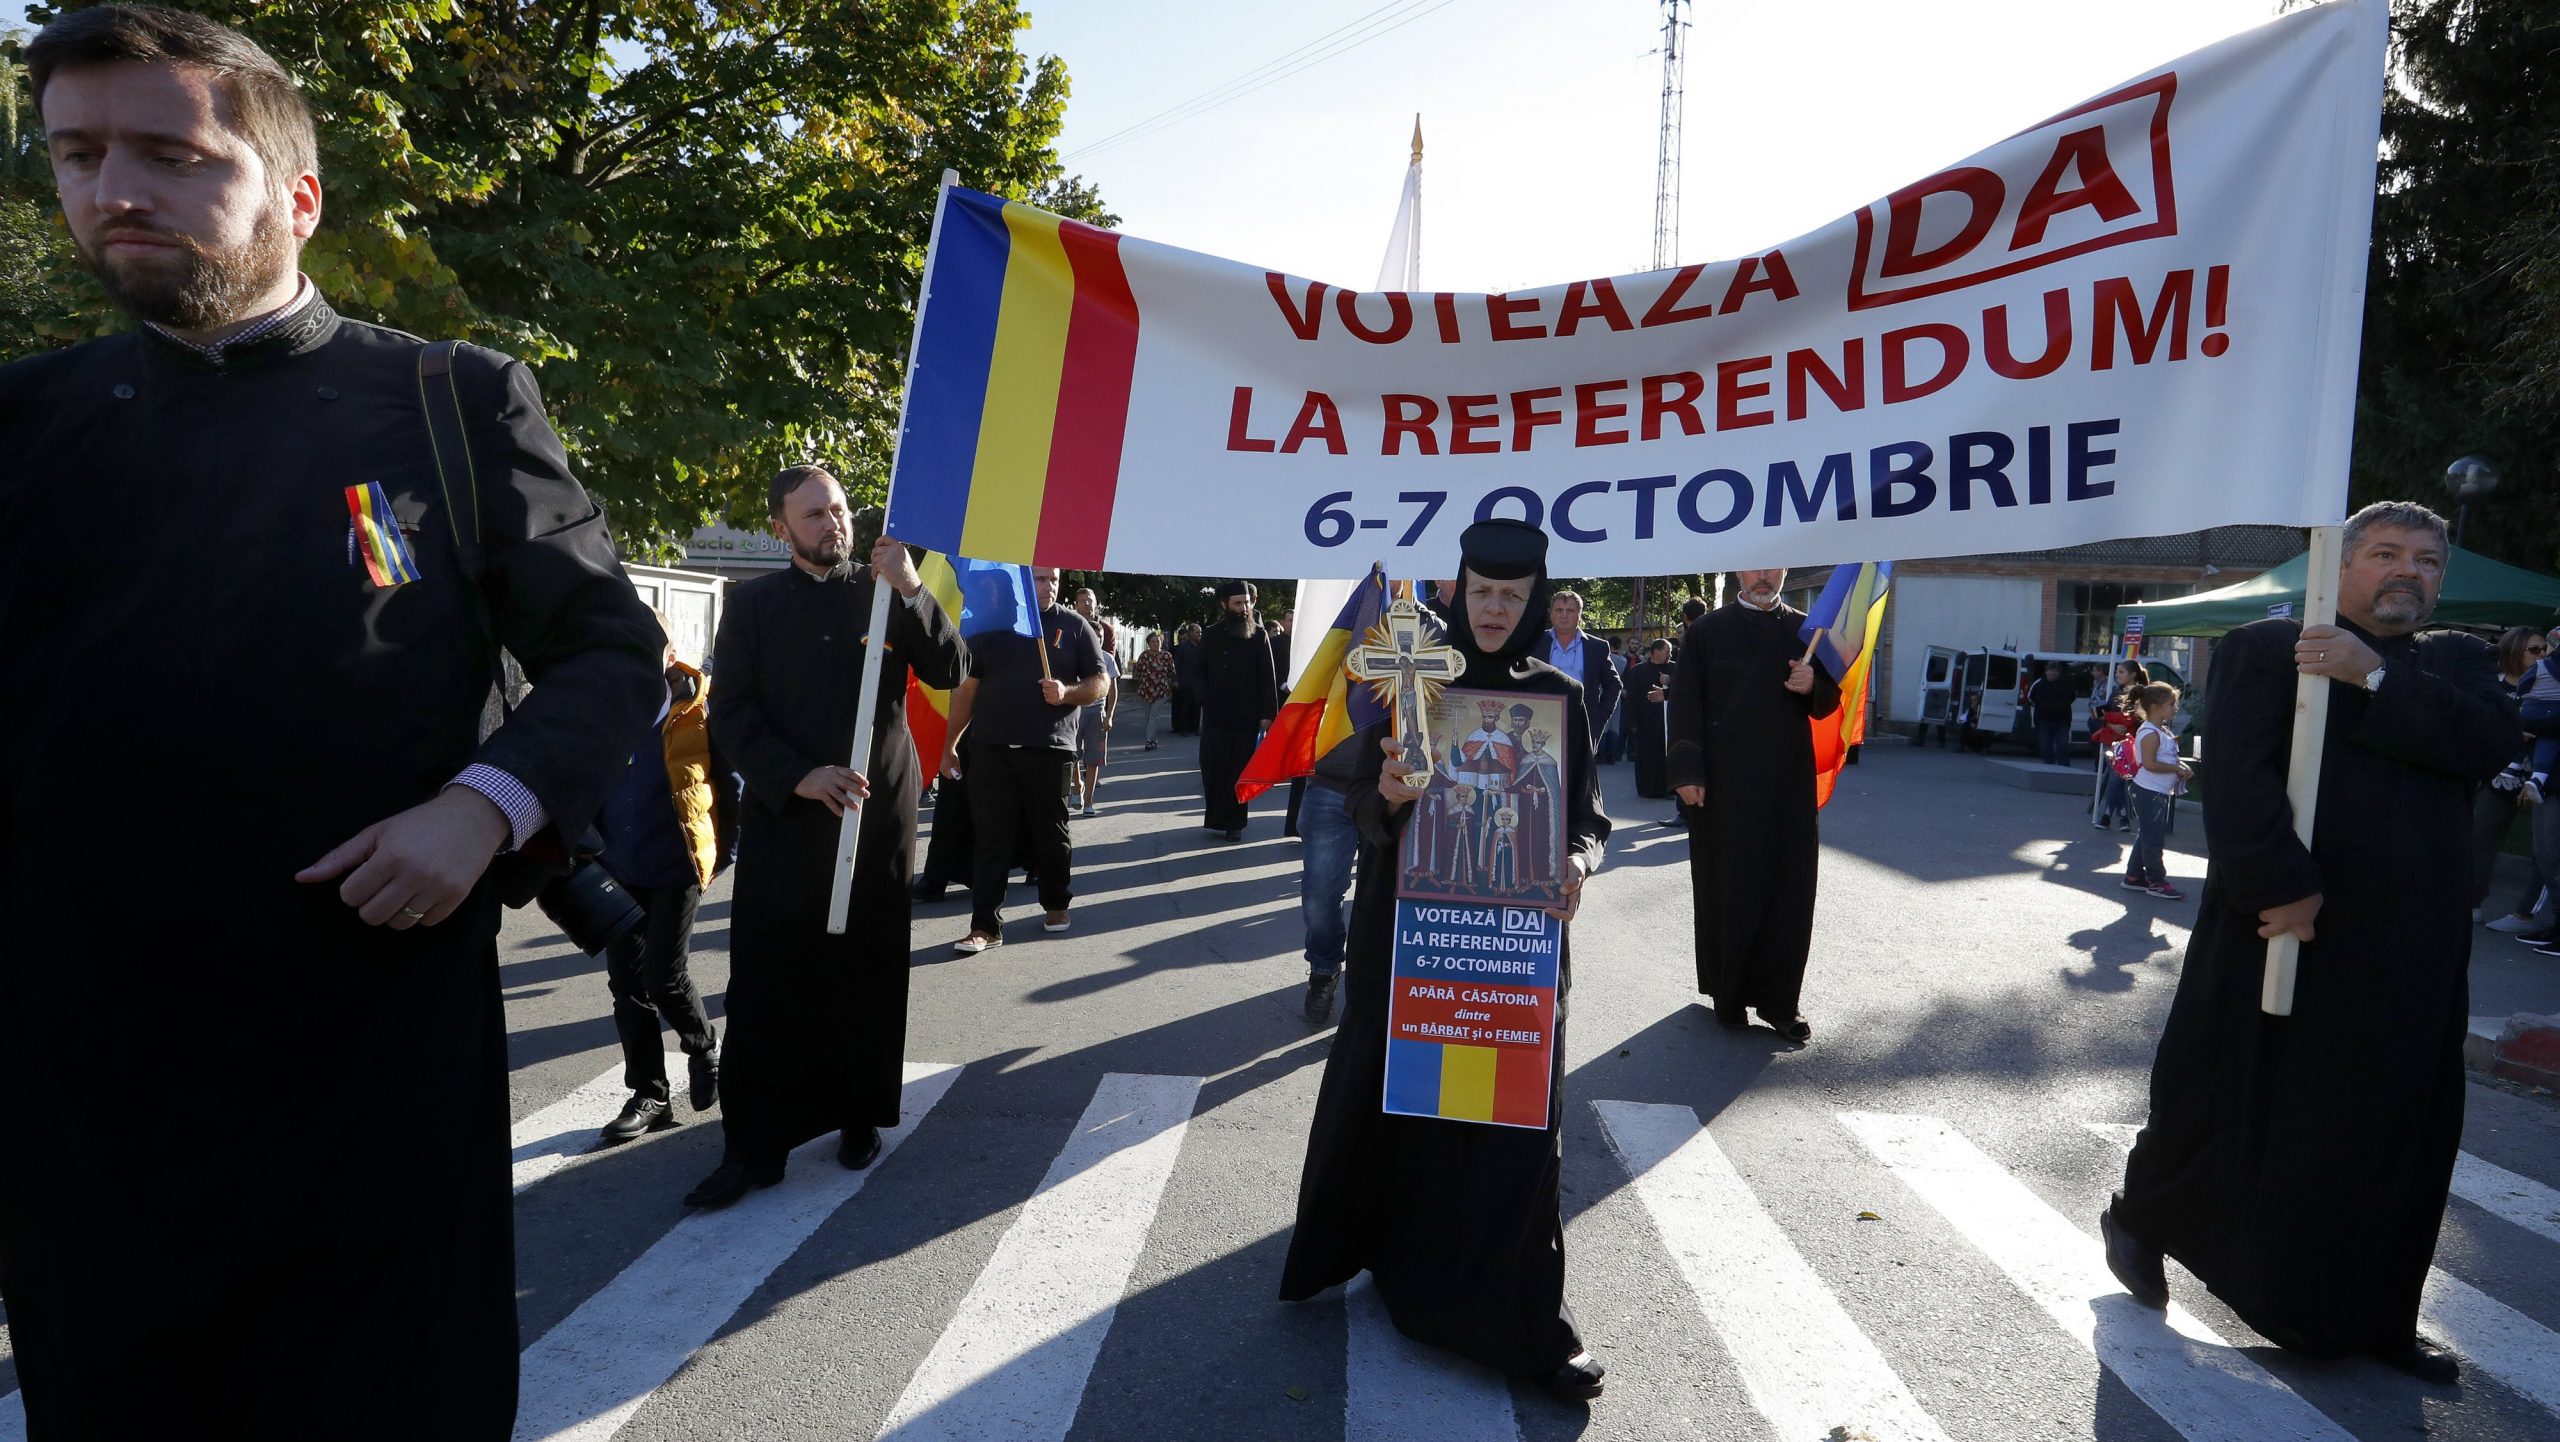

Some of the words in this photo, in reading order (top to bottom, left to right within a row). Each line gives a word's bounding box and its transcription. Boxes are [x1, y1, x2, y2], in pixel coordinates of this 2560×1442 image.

[1879, 123, 2142, 279] DA
[1226, 385, 1349, 456] LA
[1380, 264, 2231, 456] REFERENDUM!
[1303, 490, 1448, 548] 6-7
[1472, 418, 2121, 546] OCTOMBRIE
[1414, 906, 1497, 927] VOTEAZĂ
[1506, 909, 1541, 931] DA
[1402, 930, 1424, 946] LA
[1428, 932, 1553, 954] REFERENDUM!
[1416, 955, 1441, 969] 6-7
[1444, 957, 1536, 975] OCTOMBRIE
[1408, 985, 1455, 1001] APĂRĂ
[1461, 989, 1539, 1006] CĂSĂTORIA
[1454, 1008, 1491, 1022] dintre
[1402, 1023, 1418, 1033] un
[1420, 1022, 1470, 1038] BĂRBAT
[1484, 1031, 1493, 1039] o
[1495, 1029, 1541, 1043] FEMEIE
